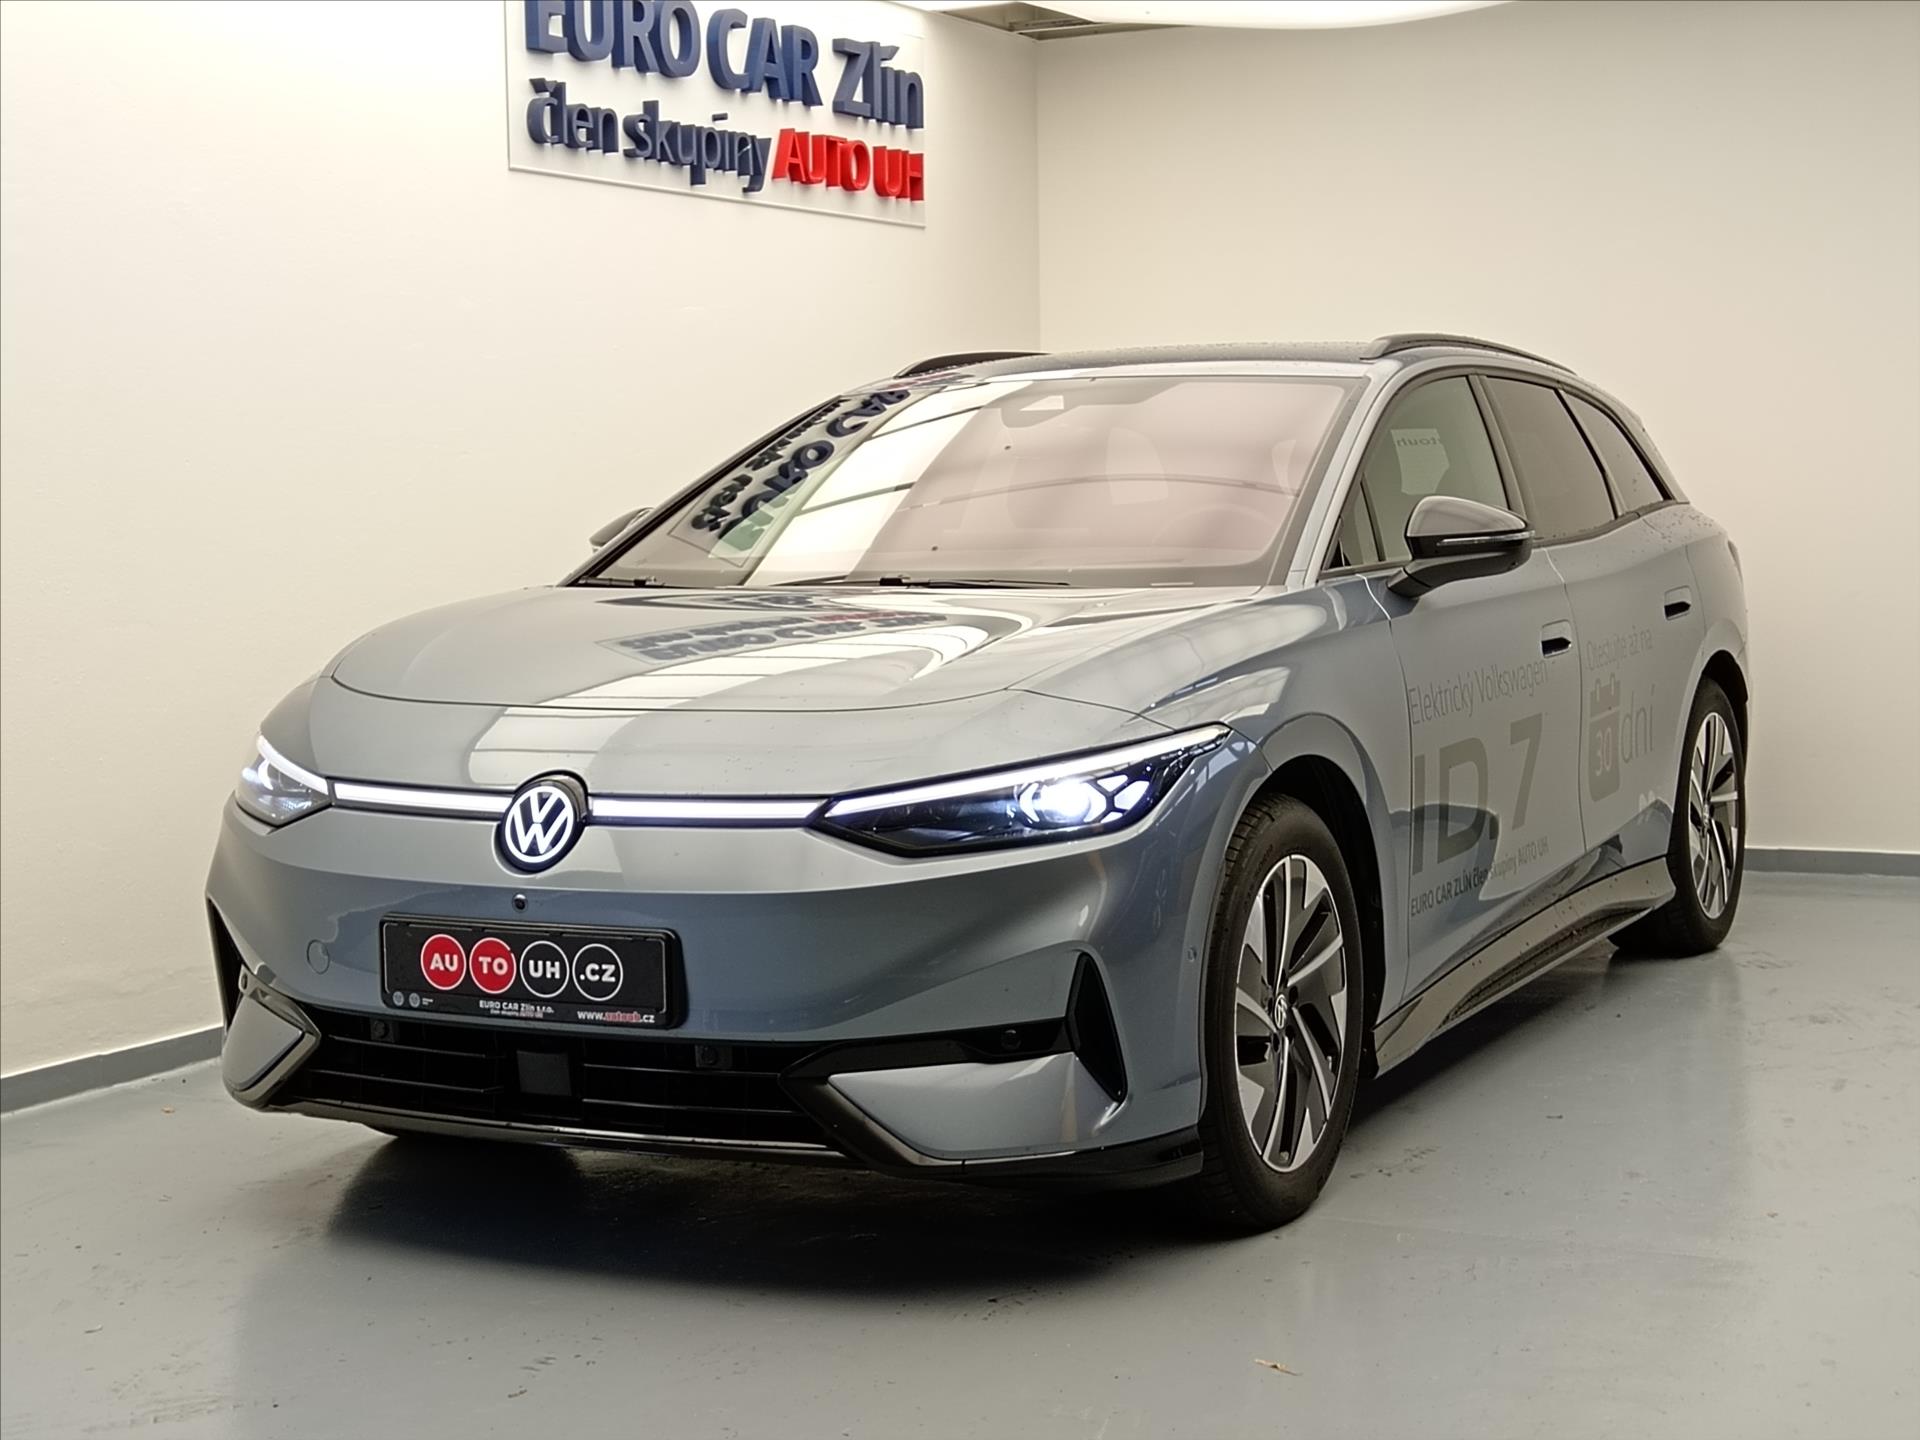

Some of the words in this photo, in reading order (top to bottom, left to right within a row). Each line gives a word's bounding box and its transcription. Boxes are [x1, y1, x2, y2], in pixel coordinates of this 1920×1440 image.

[524, 0, 701, 78] EURO
[706, 8, 824, 107] CAR
[832, 37, 925, 129] Zlín
[527, 77, 619, 154] člen
[771, 128, 871, 192] AUTO
[873, 145, 925, 201] UH
[1408, 672, 1474, 725] Elektrický
[1474, 660, 1548, 703] Volkswagen
[1595, 726, 1612, 777] 30
[1411, 889, 1434, 917] EURO
[1435, 880, 1453, 906] CAR
[430, 952, 459, 972] AU
[478, 956, 509, 976] TO
[528, 959, 561, 980] UH
[579, 963, 616, 983] .CZ
[501, 1001, 519, 1012] CAR
